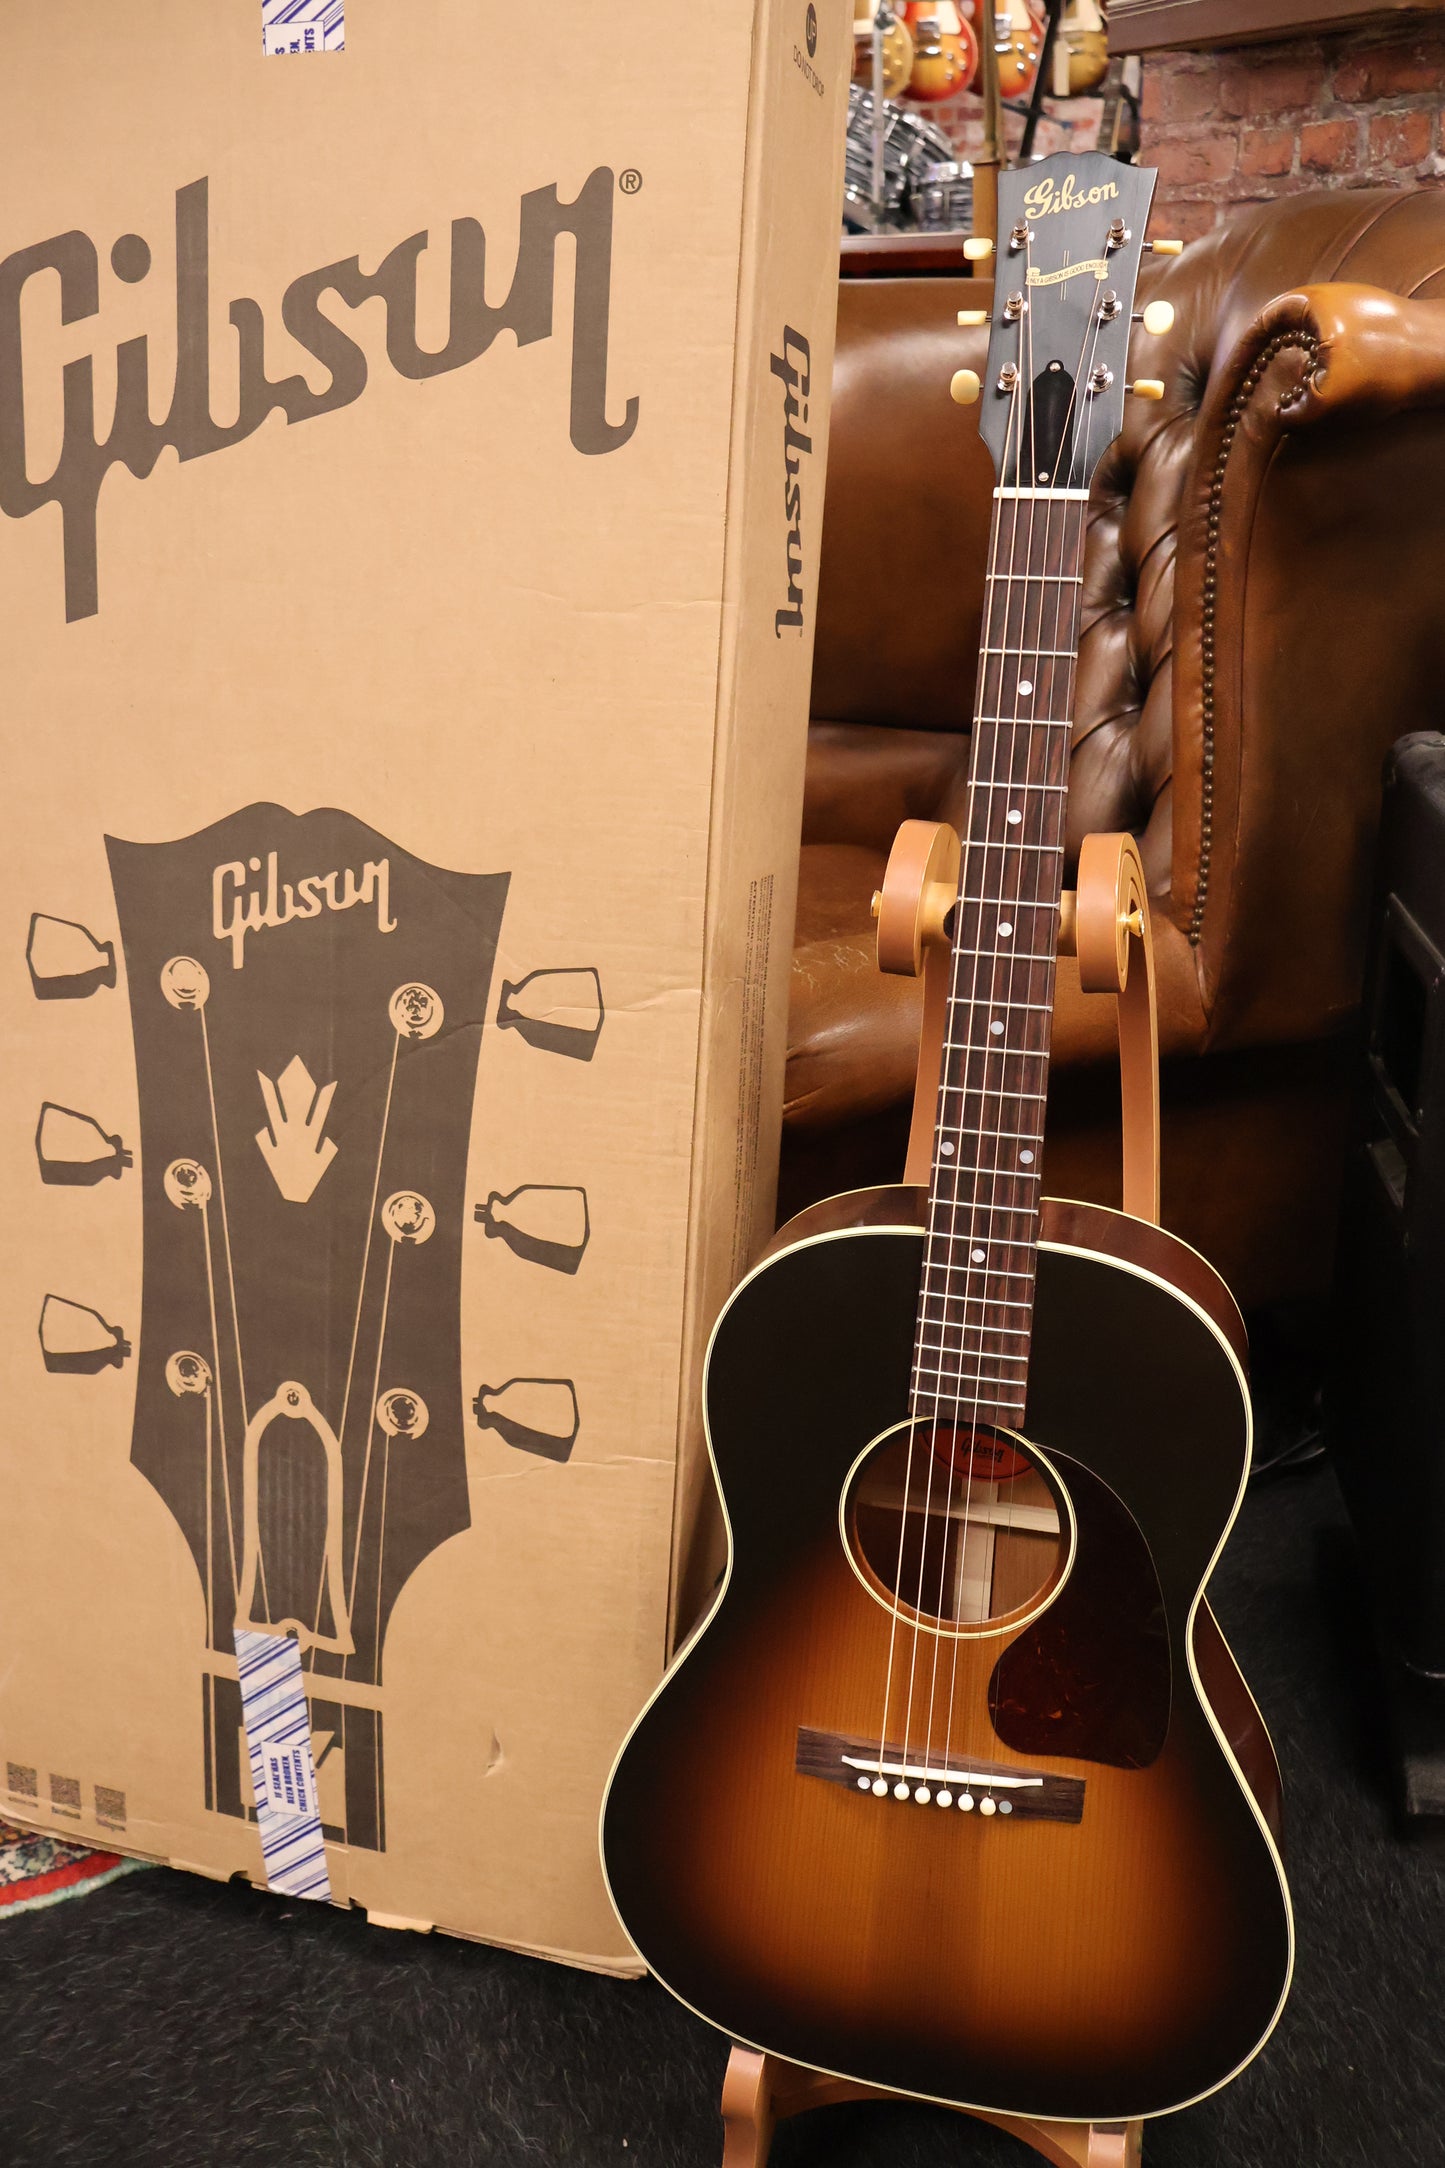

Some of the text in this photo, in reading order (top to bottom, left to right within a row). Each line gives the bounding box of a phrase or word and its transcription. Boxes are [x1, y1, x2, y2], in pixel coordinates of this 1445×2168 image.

[304, 28, 315, 53] NTS
[1024, 174, 1119, 219] Gibson
[1070, 265, 1085, 274] GOOD
[770, 324, 812, 639] Gibson
[213, 852, 397, 969] Gibson
[270, 1757, 282, 1799] IF SEAL HAS
[285, 1786, 295, 1804] BEEN
[293, 1749, 307, 1812] CHECK CONTENTS
